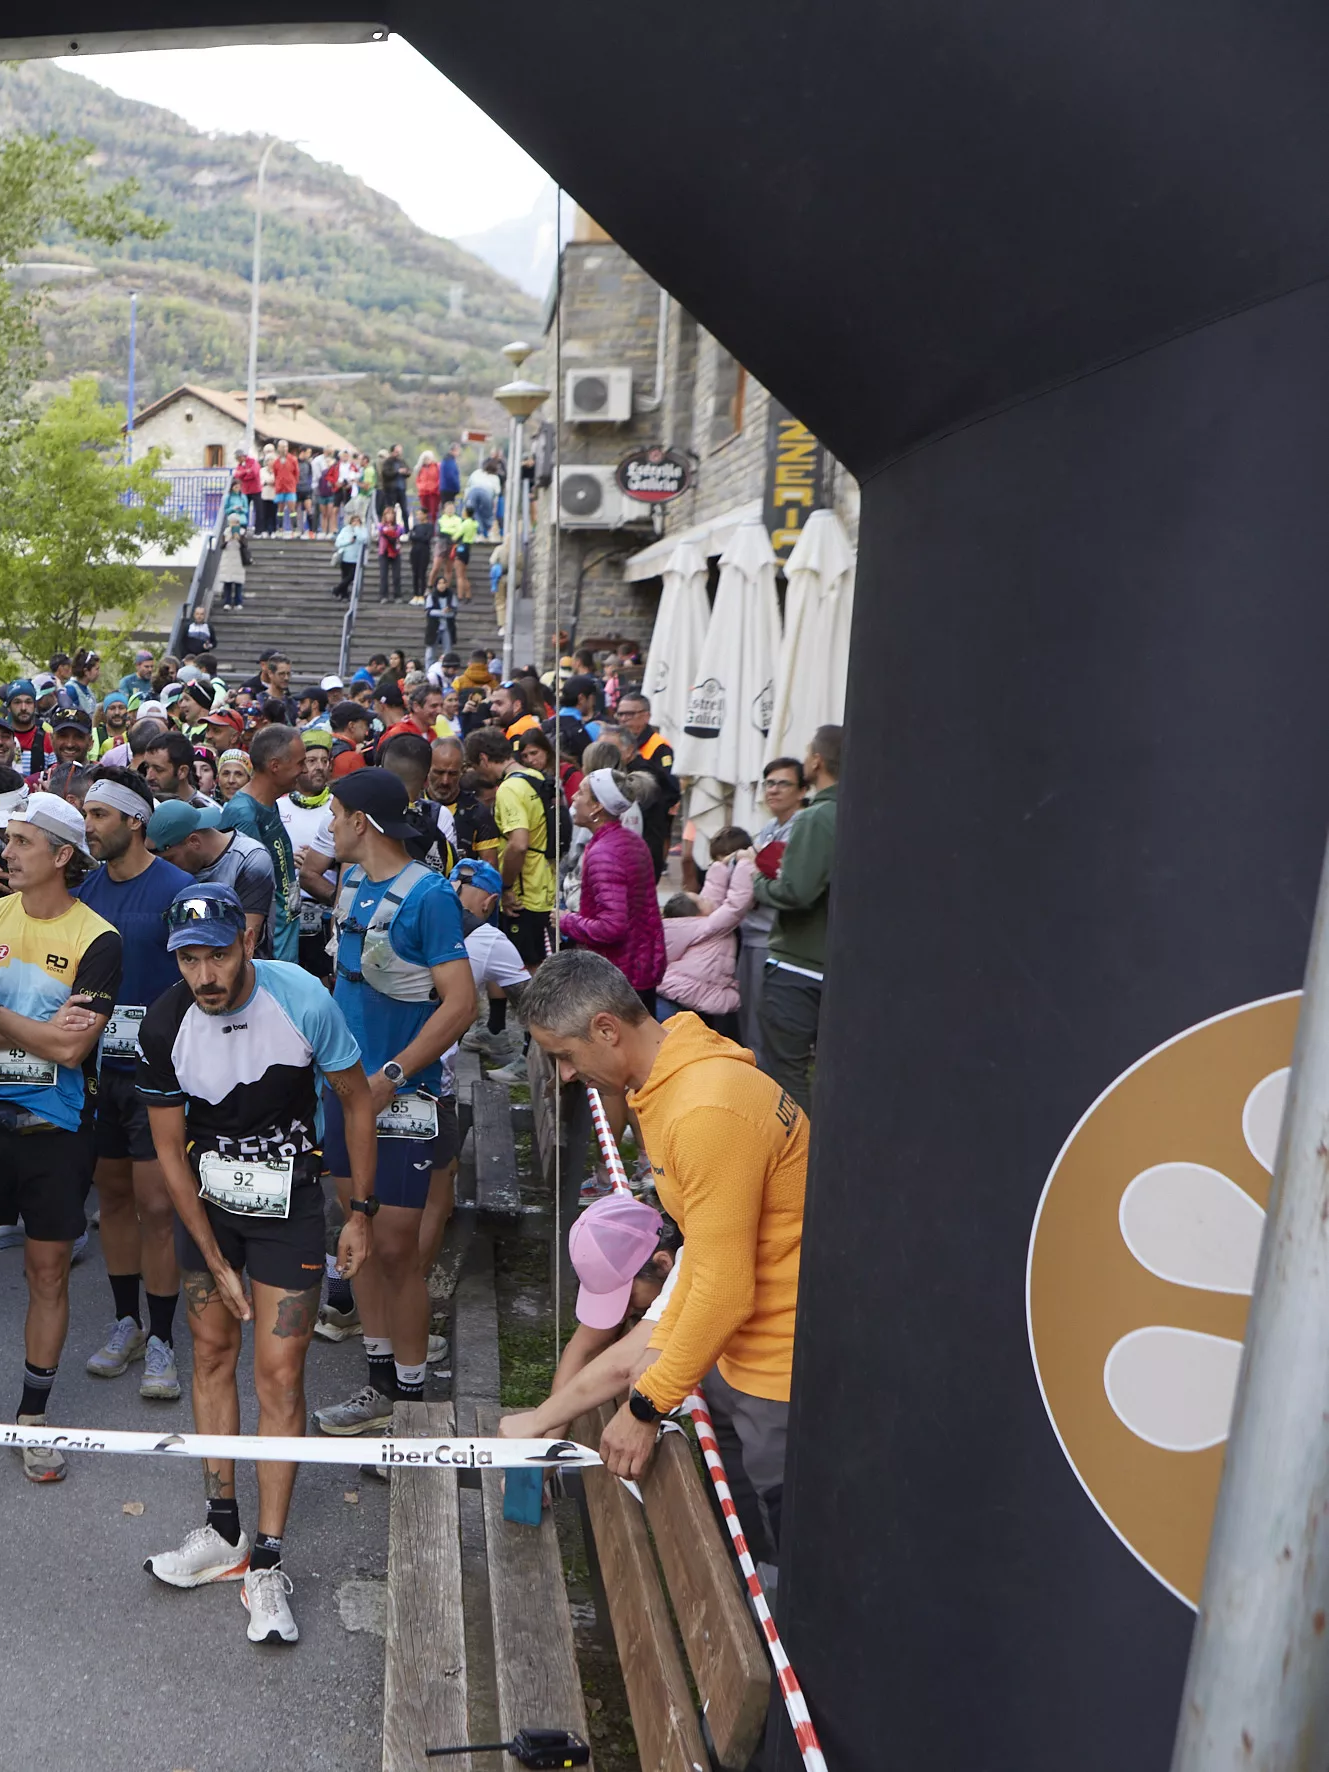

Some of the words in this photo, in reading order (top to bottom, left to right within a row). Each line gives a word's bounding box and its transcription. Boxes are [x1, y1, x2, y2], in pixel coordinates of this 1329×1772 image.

[303, 912, 315, 920] 83
[9, 1049, 26, 1058] 45
[391, 1100, 409, 1114] 65
[233, 1171, 254, 1187] 92
[381, 1444, 493, 1468] iberCaja
